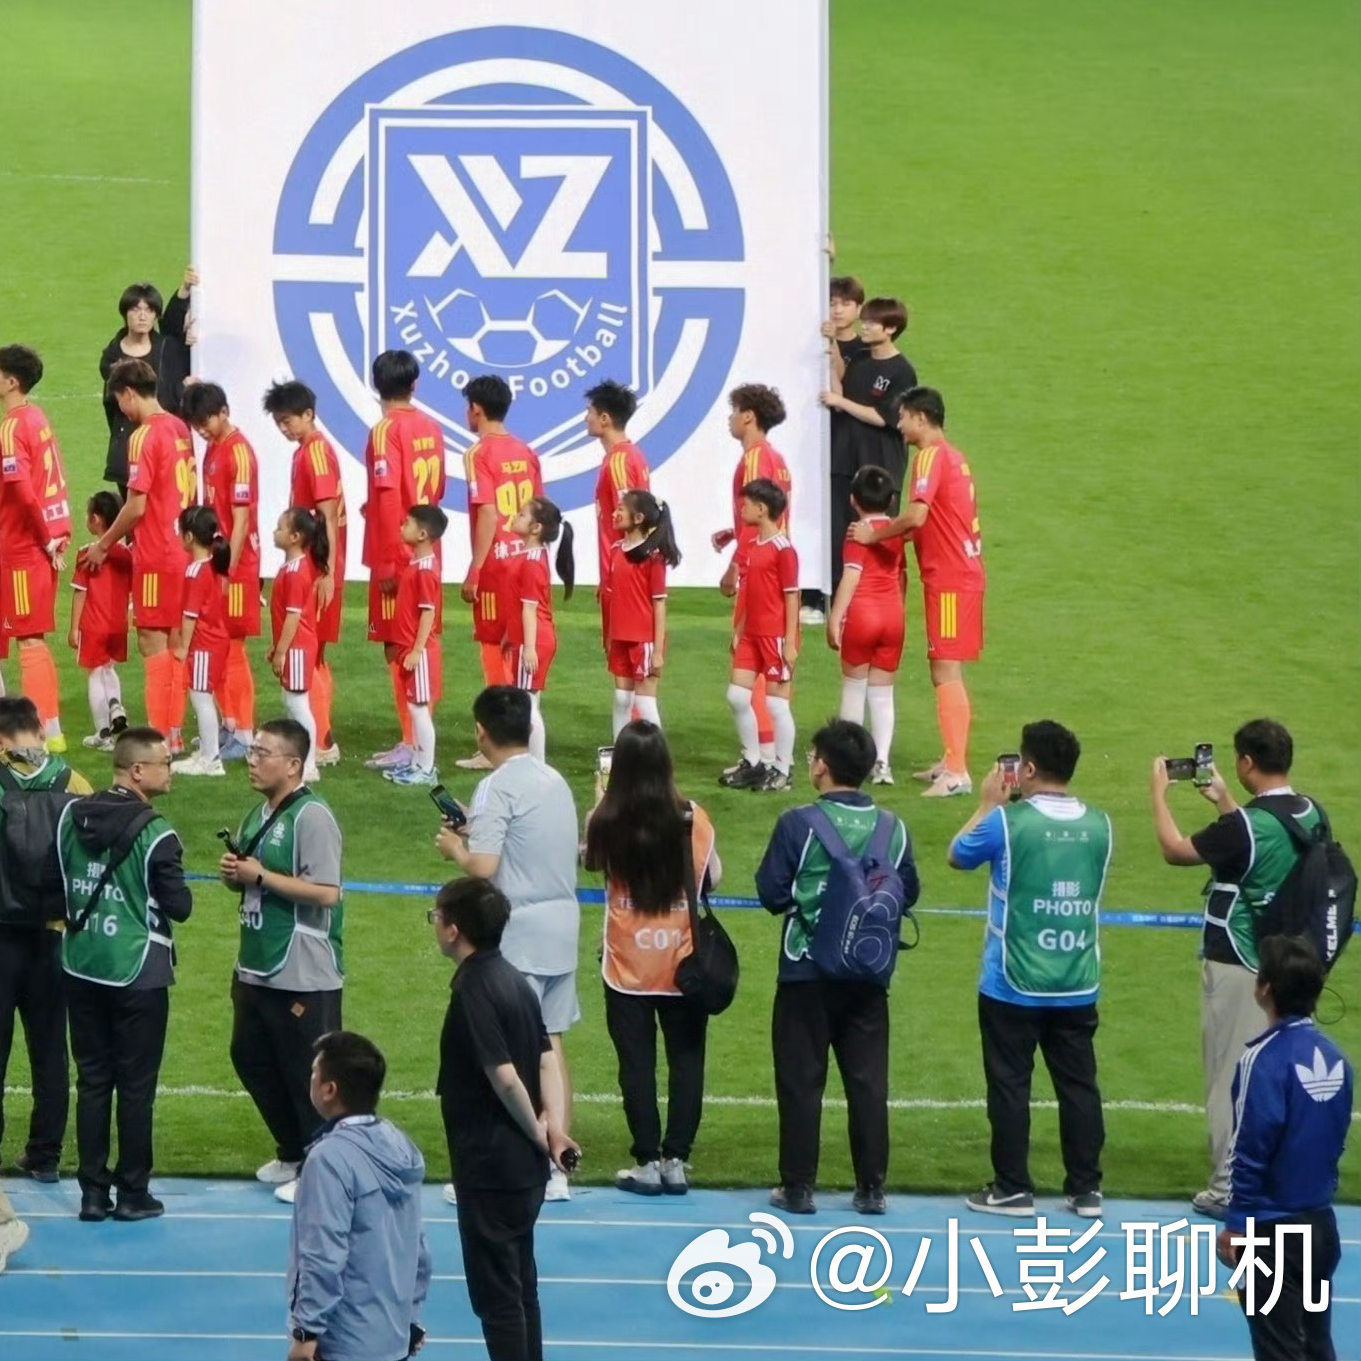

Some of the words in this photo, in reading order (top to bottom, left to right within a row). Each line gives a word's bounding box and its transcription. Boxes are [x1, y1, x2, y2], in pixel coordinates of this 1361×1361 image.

[389, 299, 473, 392] Xuzho
[507, 300, 629, 402] Football
[494, 538, 527, 561] 徐工
[1052, 881, 1081, 897] 摄影
[1032, 898, 1092, 917] PHOTO
[1037, 928, 1087, 952] G04
